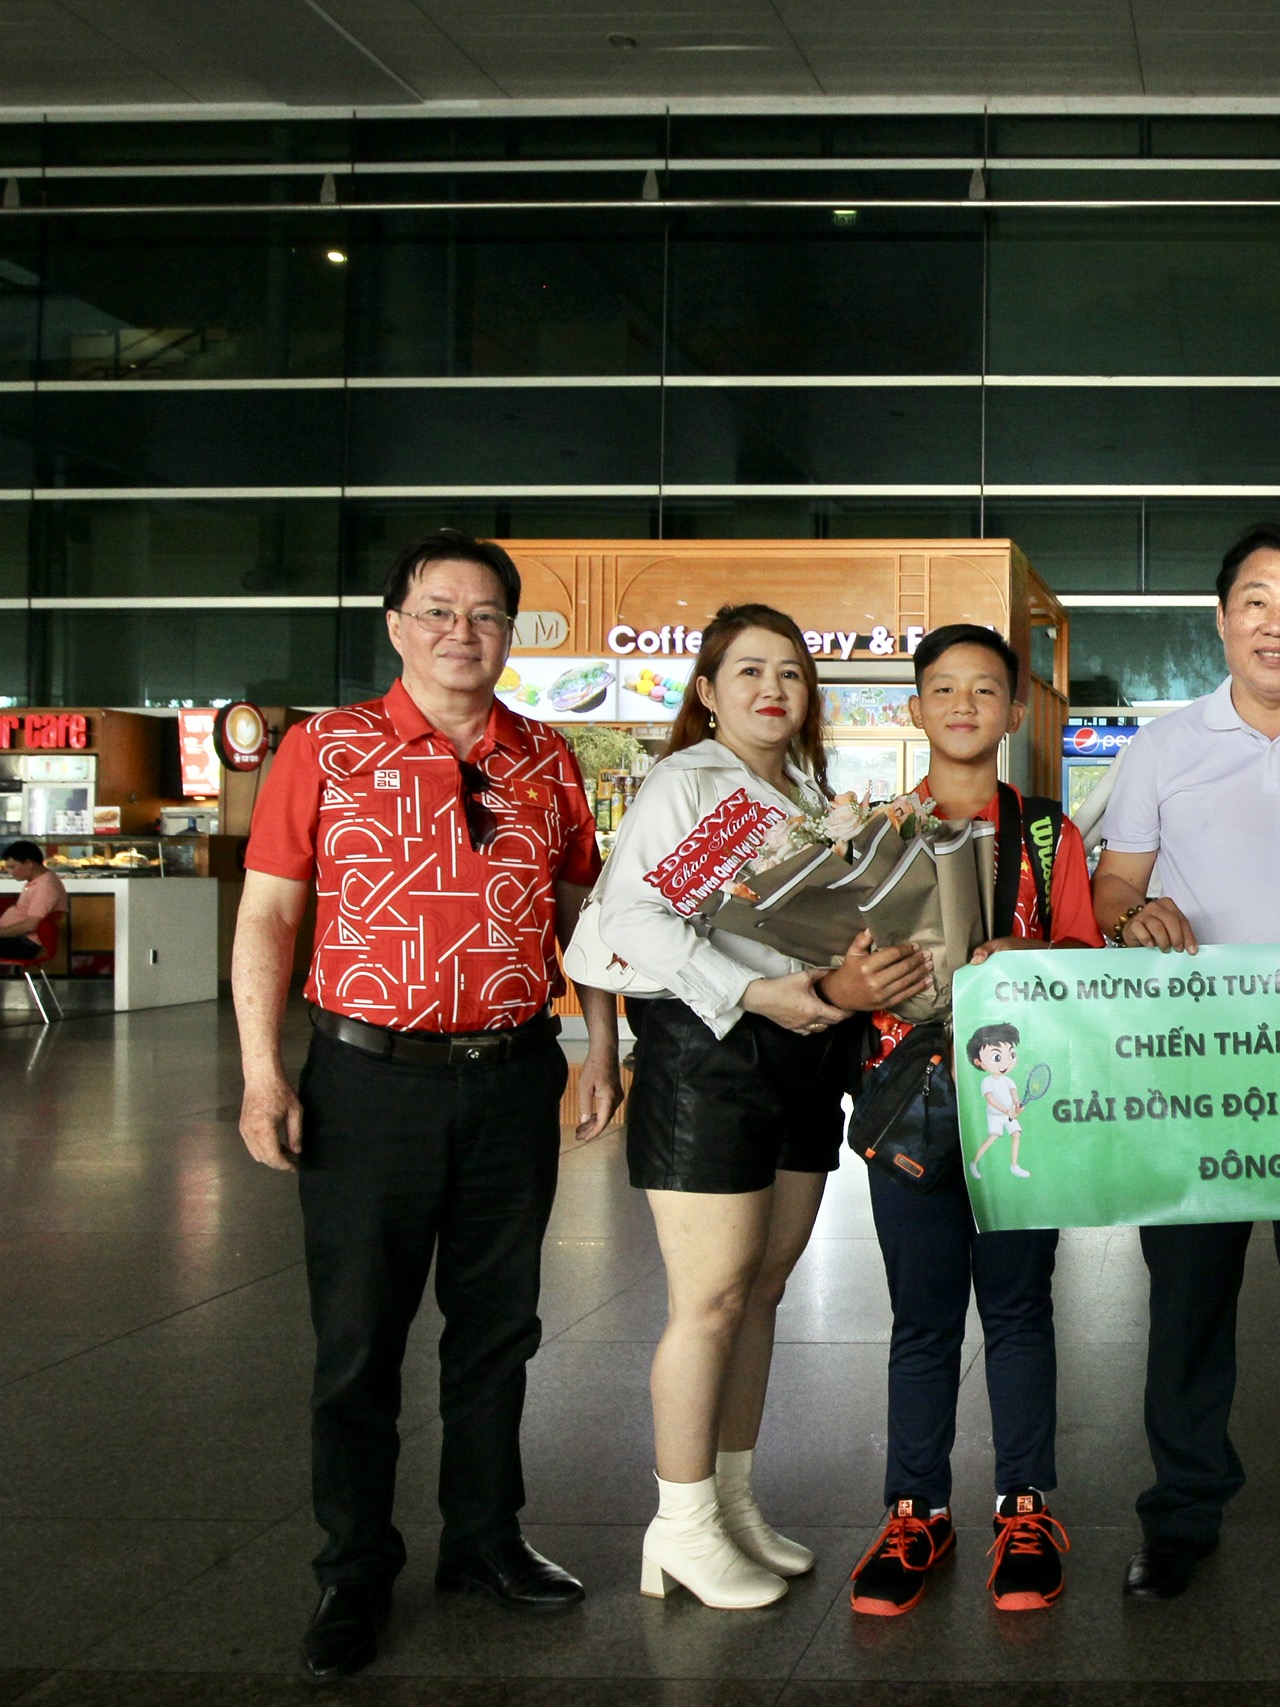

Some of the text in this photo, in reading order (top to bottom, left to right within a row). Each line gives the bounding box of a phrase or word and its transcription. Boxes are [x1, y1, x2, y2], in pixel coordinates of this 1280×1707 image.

[608, 624, 702, 654] Coffe
[802, 629, 857, 660] ery
[868, 625, 895, 655] &
[995, 975, 1069, 1002] CHÀO
[1077, 974, 1160, 1000] MỪNG
[1167, 971, 1217, 1002] ĐỘI
[1115, 1026, 1206, 1058] CHIẾN
[1052, 1090, 1117, 1123] GIẢI
[1124, 1088, 1213, 1120] ĐỒNG
[1221, 1086, 1278, 1122] ĐỘI
